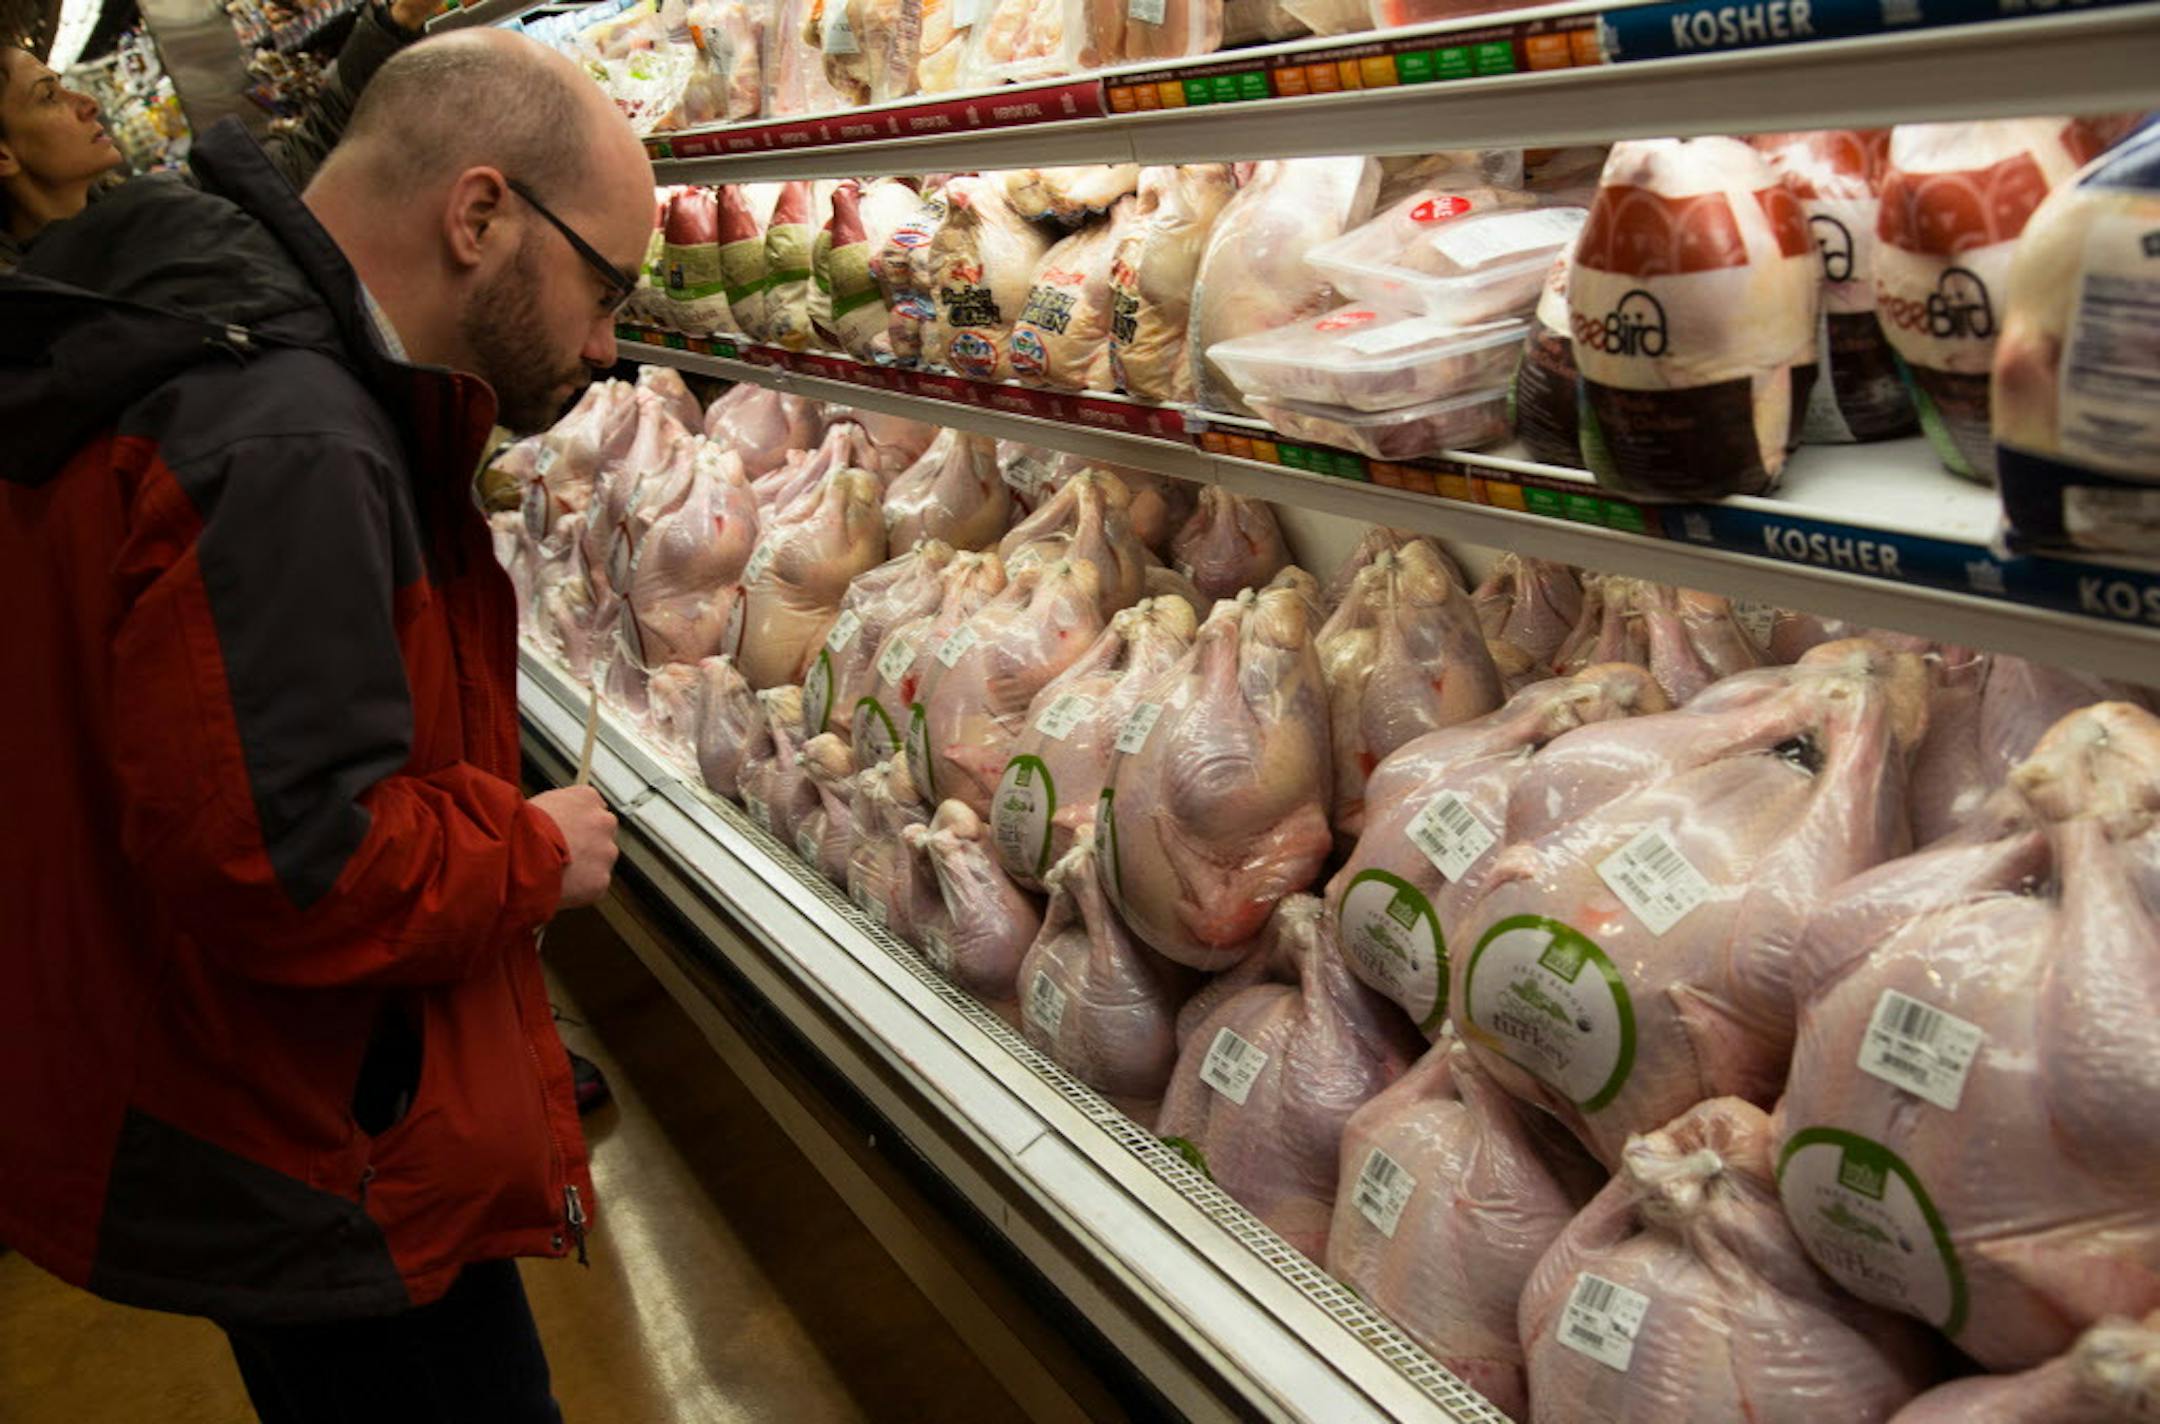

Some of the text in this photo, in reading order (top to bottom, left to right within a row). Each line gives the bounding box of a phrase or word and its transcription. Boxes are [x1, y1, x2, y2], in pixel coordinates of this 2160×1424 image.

[1671, 0, 1815, 48] KOSHER
[1762, 524, 1903, 577] KOSHER
[1493, 1012, 1570, 1071] turkey
